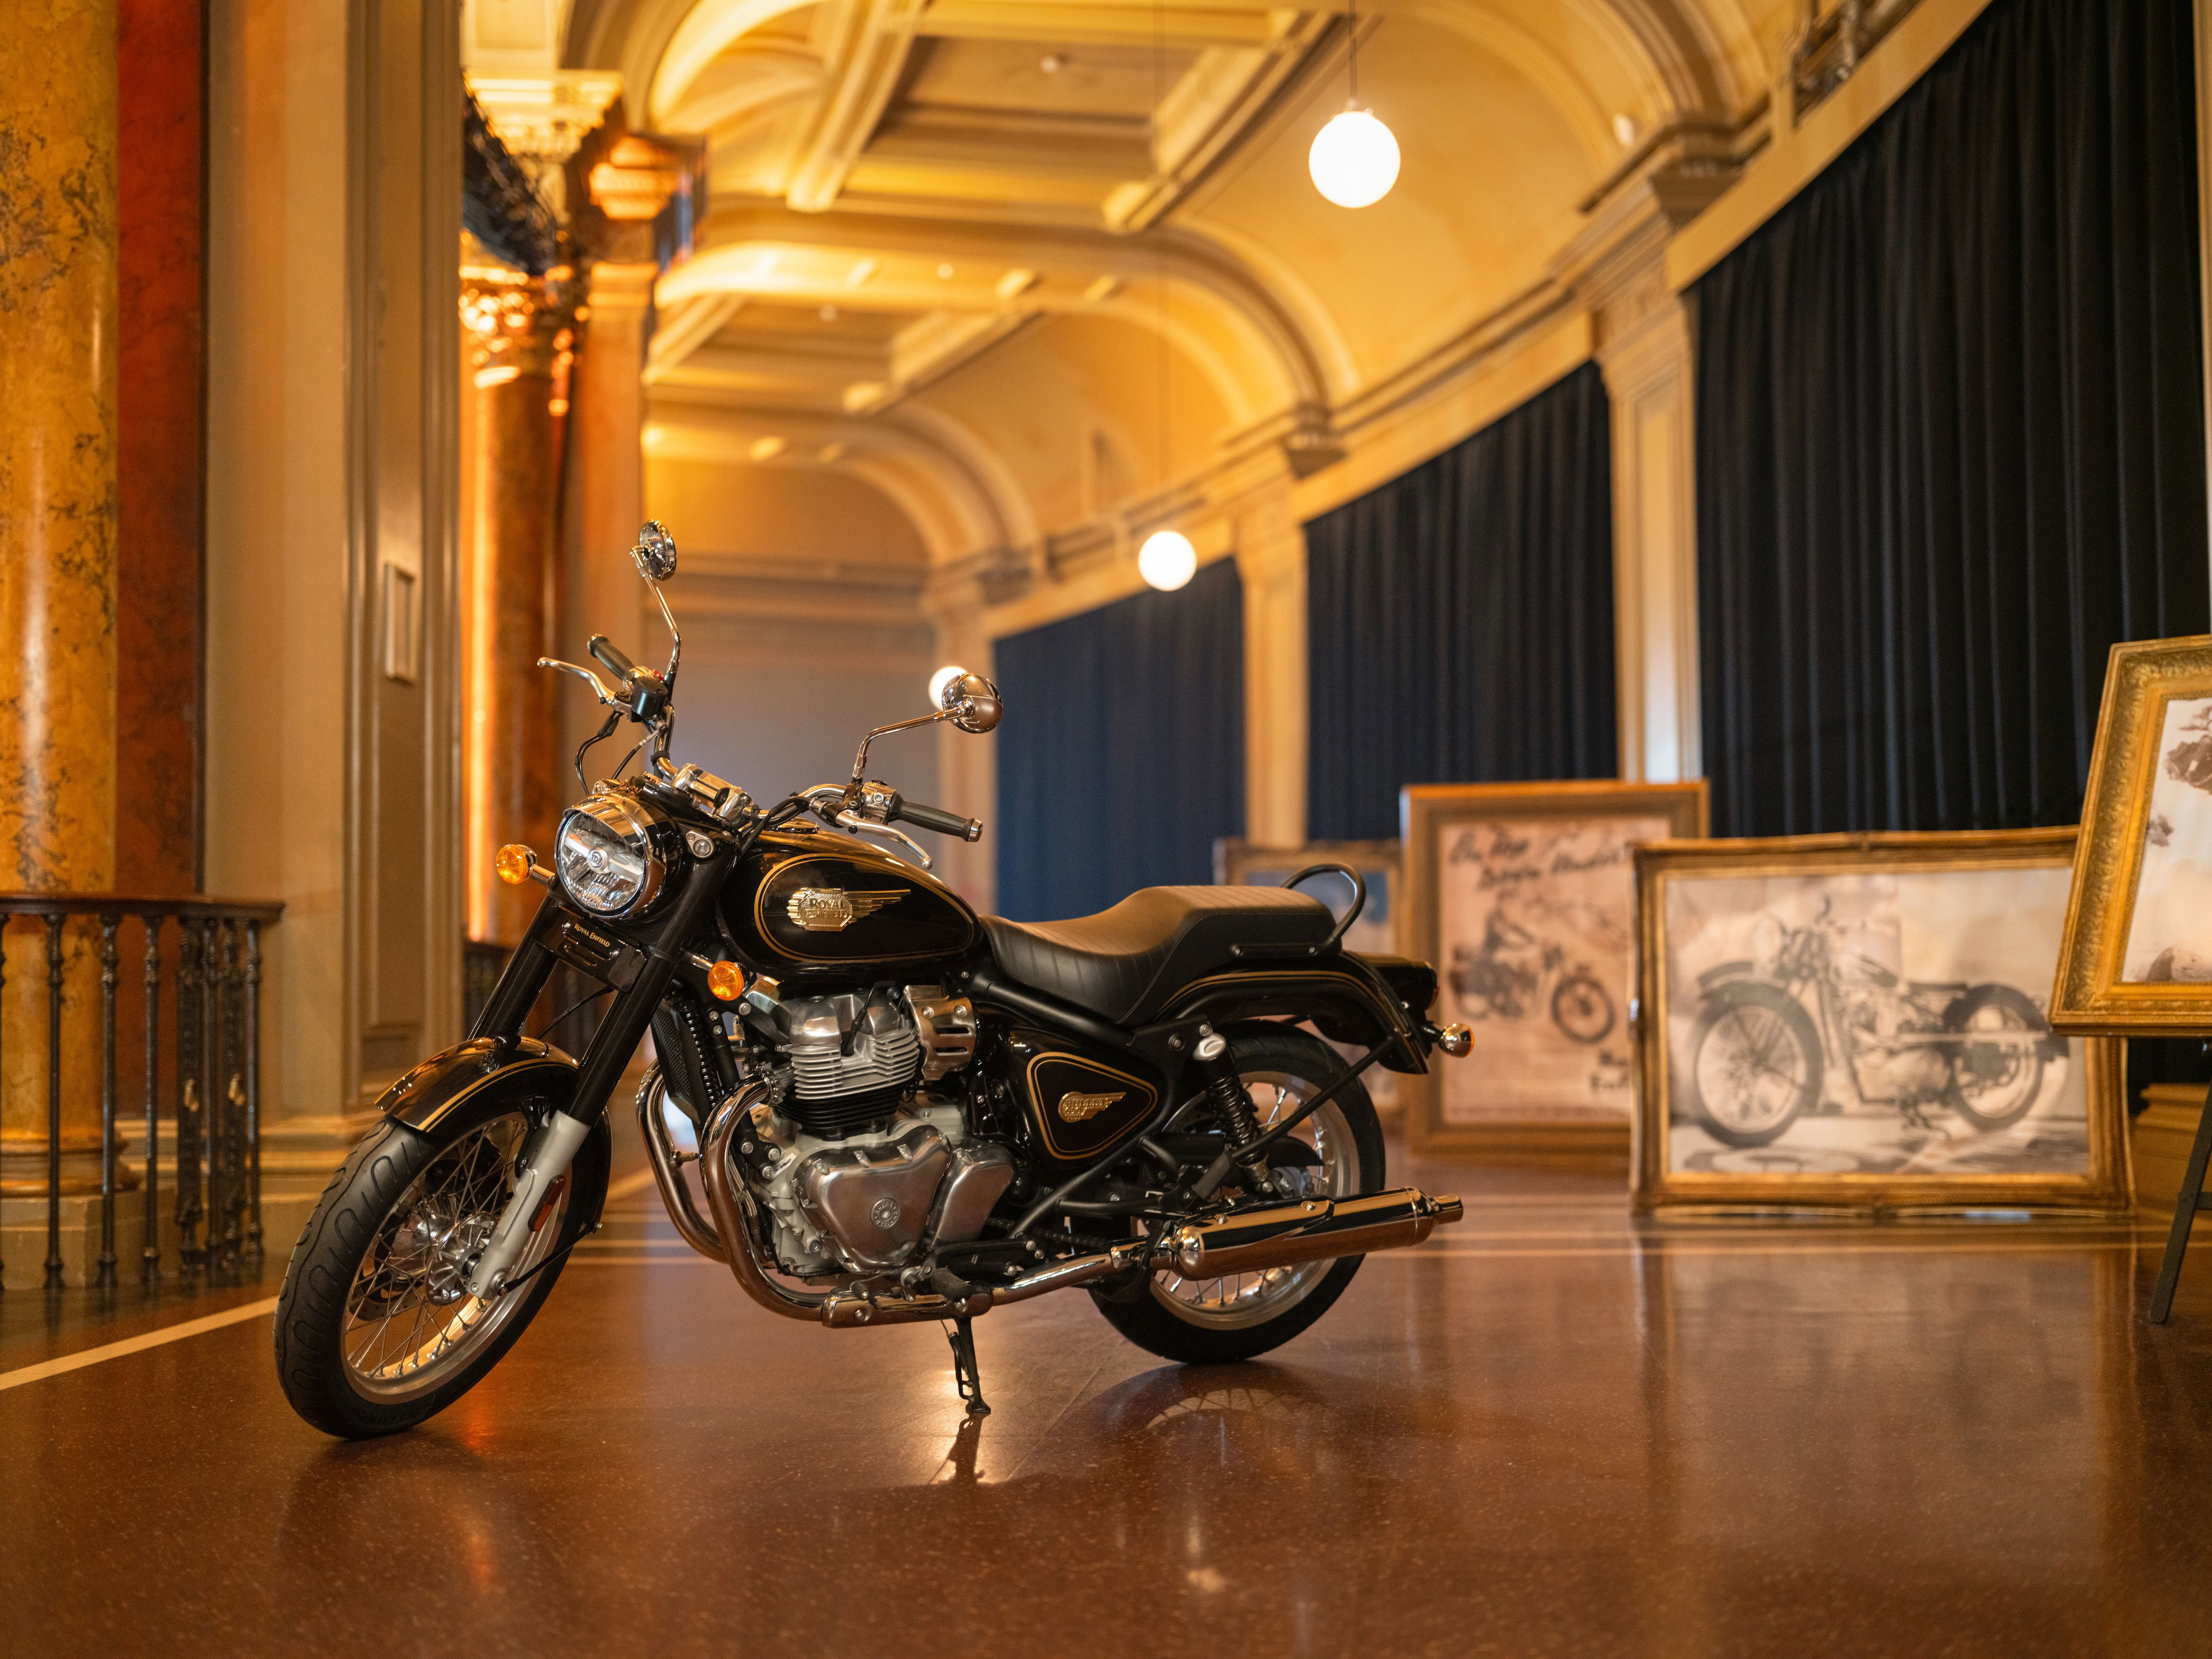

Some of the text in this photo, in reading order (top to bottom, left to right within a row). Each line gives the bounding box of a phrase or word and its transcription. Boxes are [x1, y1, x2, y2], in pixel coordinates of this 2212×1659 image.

[809, 898, 845, 909] ROYAL
[574, 923, 611, 947] ROYAL ENFIELD
